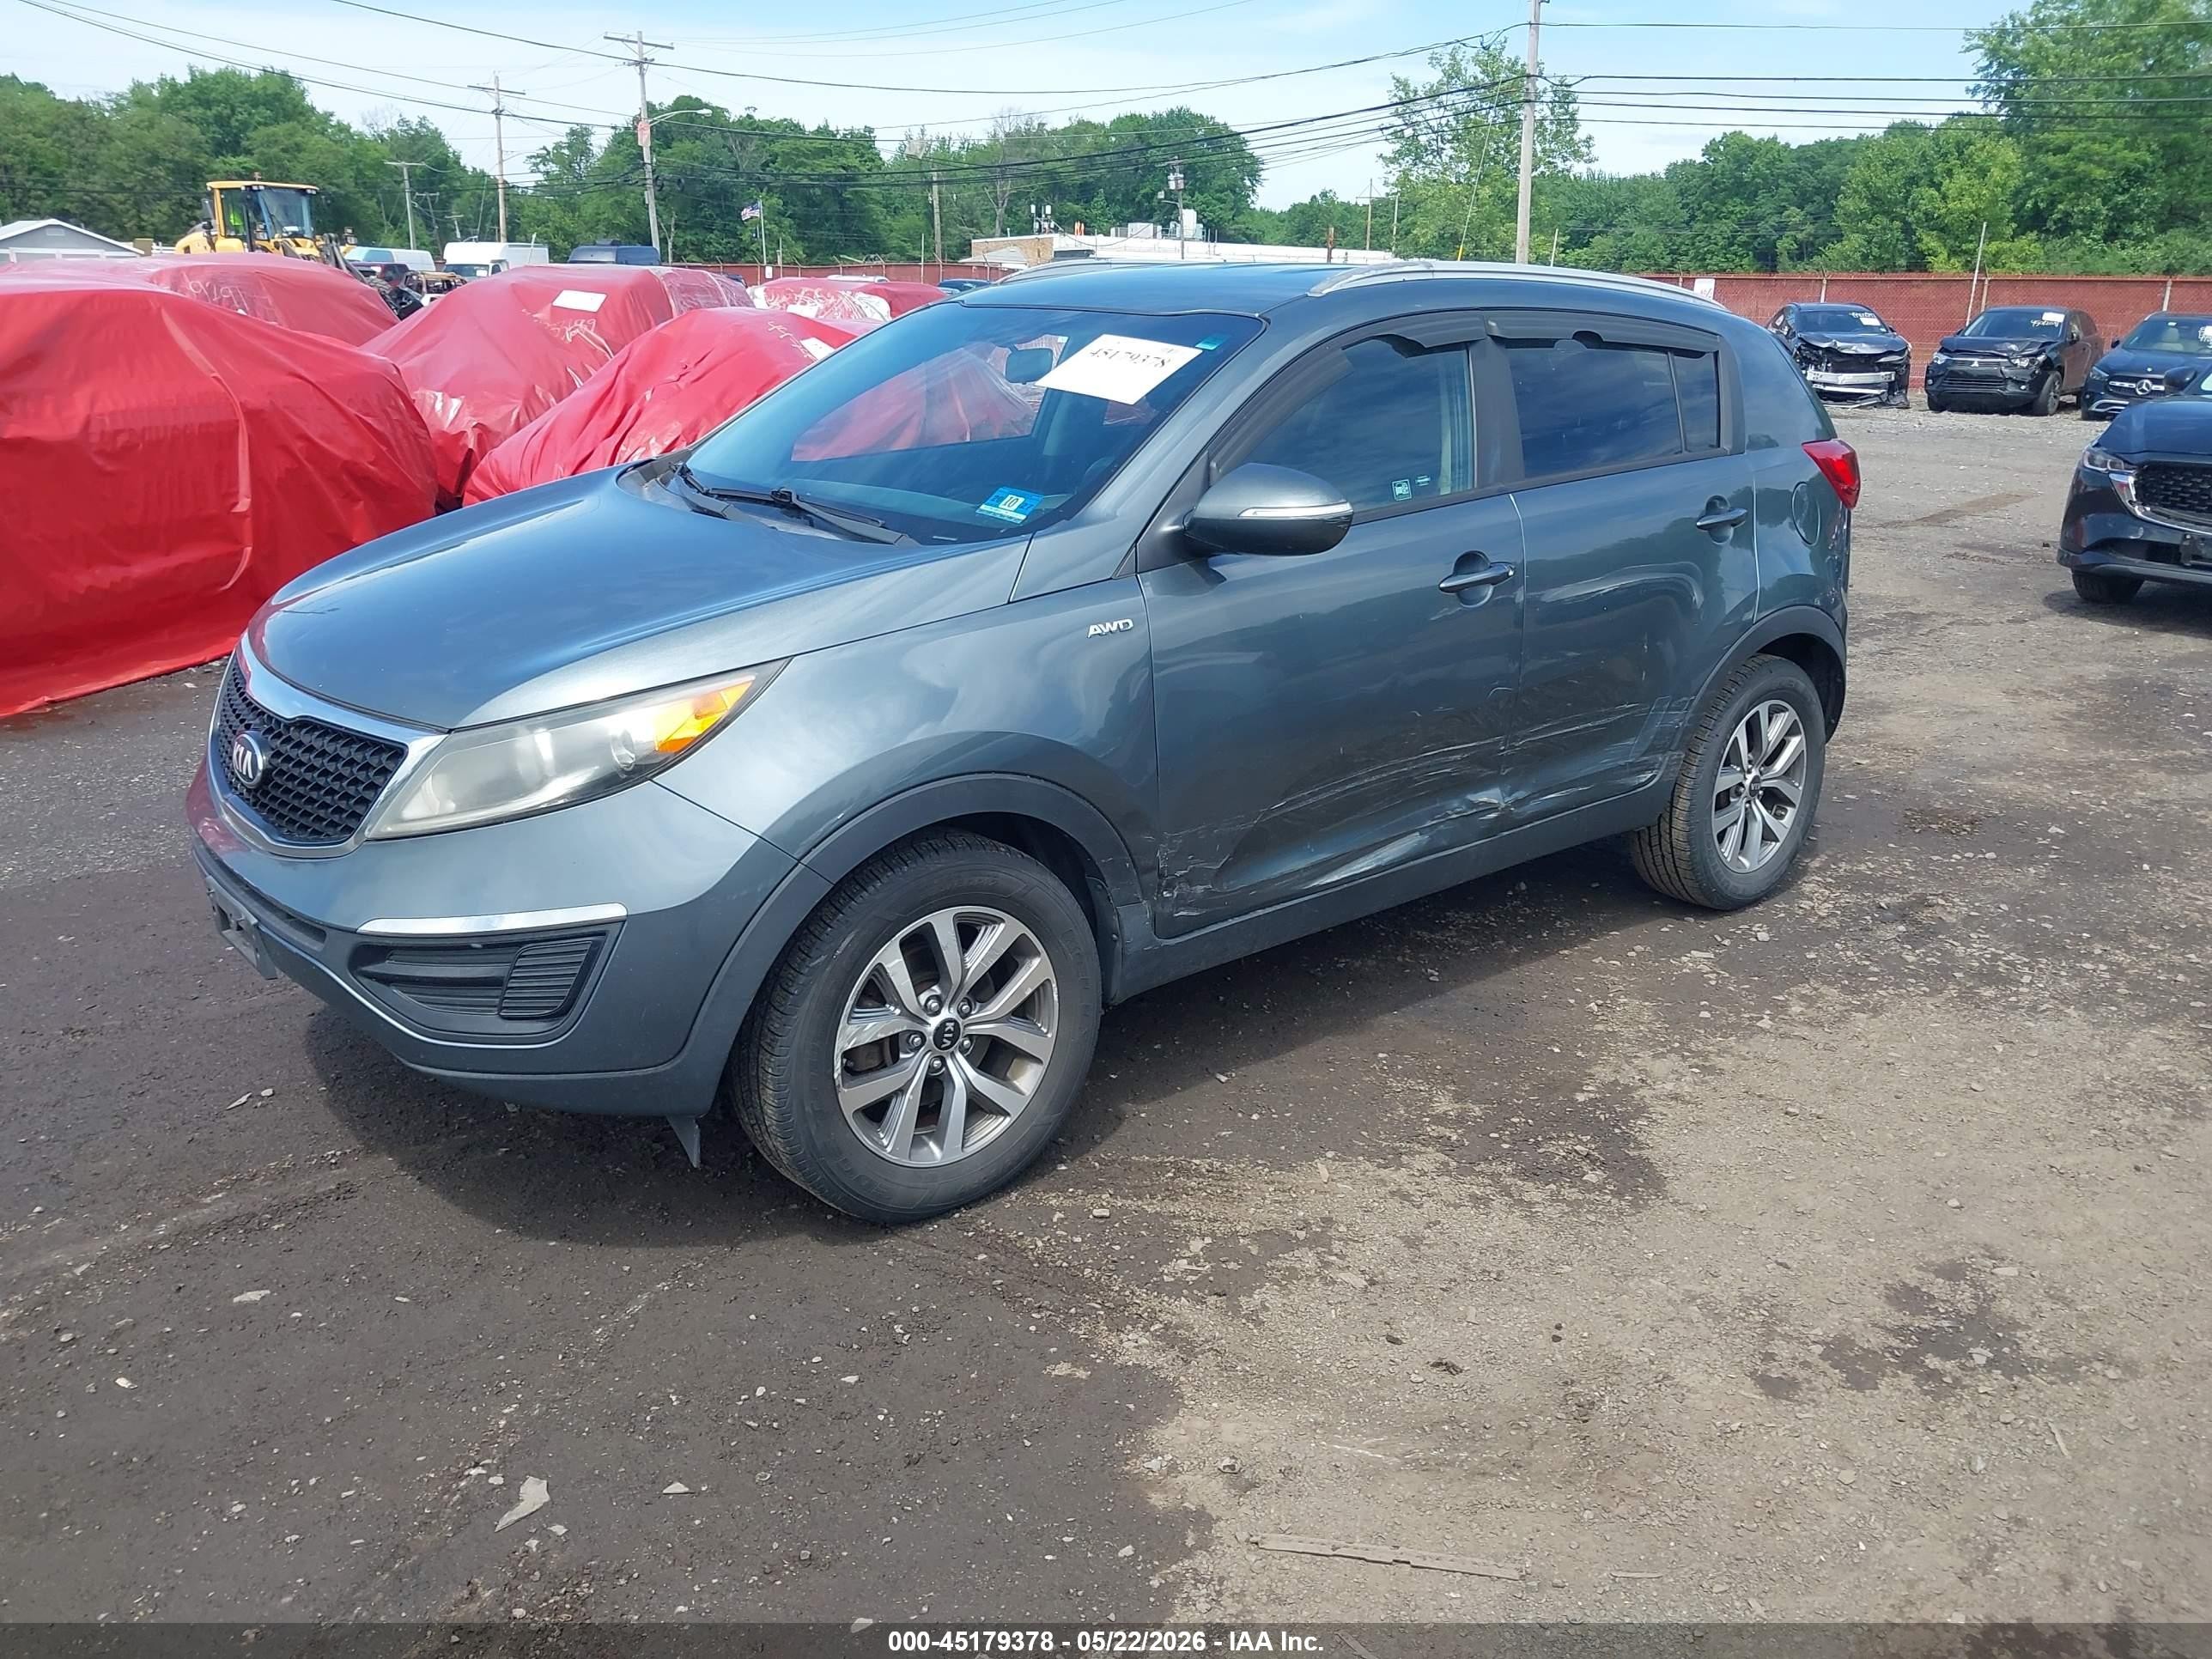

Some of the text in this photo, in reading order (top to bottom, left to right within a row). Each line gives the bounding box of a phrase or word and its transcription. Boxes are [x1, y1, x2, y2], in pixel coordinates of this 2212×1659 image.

[1003, 496, 1019, 508] 10
[1086, 618, 1133, 639] AWD
[233, 741, 253, 780] KIA
[940, 1022, 955, 1048] KIA
